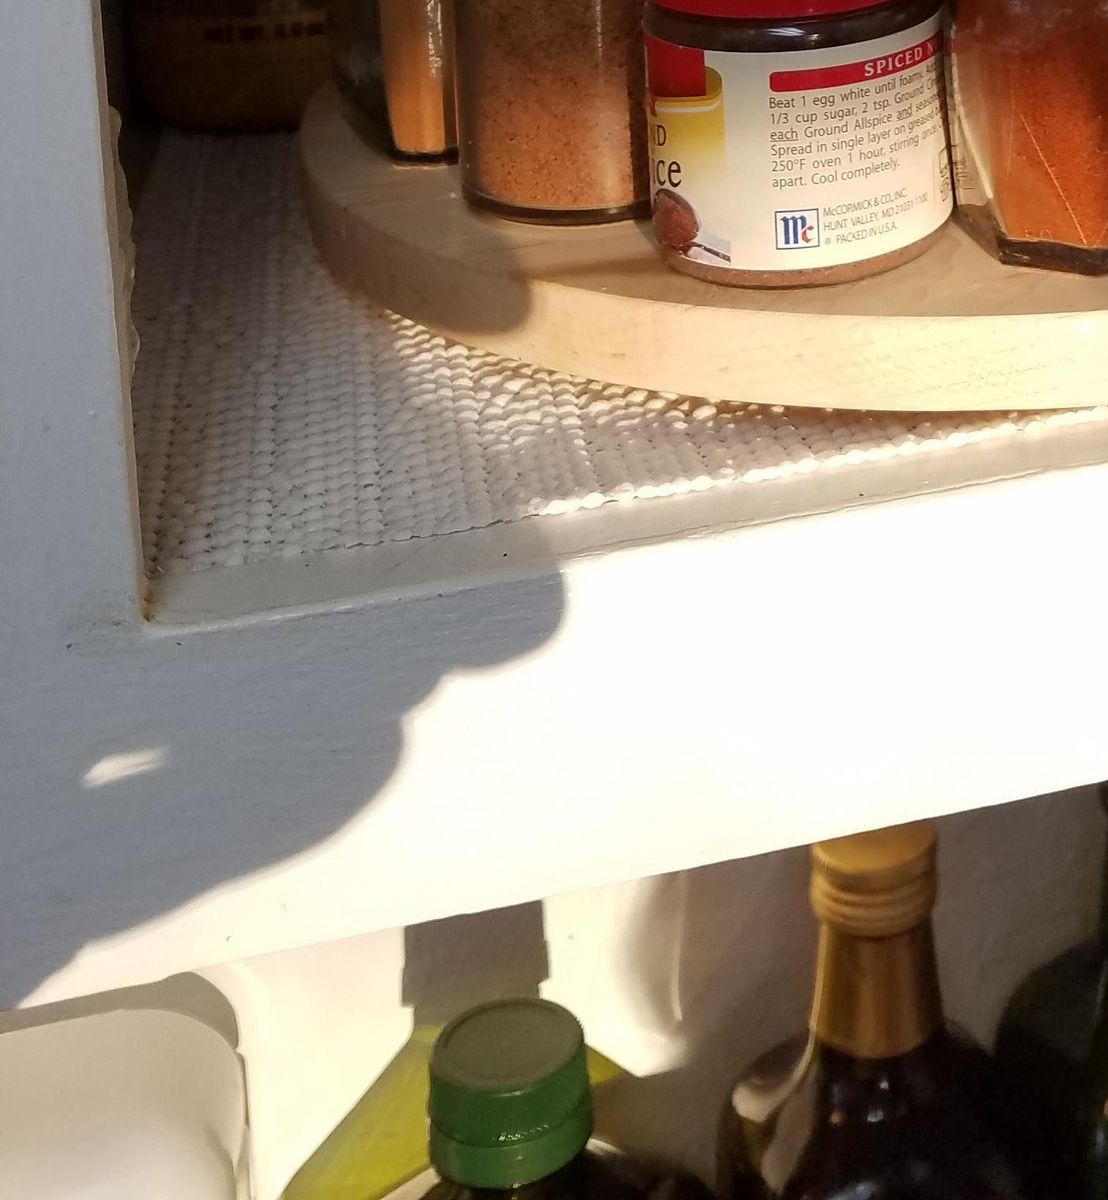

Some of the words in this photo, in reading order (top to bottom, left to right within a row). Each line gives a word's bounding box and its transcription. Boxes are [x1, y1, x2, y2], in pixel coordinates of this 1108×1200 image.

[864, 47, 923, 76] SPICED
[769, 97, 796, 109] Beat
[802, 96, 806, 107] 1
[813, 94, 836, 108] egg
[840, 87, 871, 102] white
[875, 80, 897, 94] until
[770, 113, 789, 125] 1/3
[795, 113, 818, 126] cup
[824, 106, 857, 122] sugar,
[862, 102, 868, 114] 2
[873, 99, 891, 111] tsp.
[894, 81, 924, 104] Ground
[770, 127, 799, 141] each
[804, 123, 848, 138] Ground
[854, 111, 892, 130] Allspice
[896, 104, 912, 121] and
[771, 141, 812, 158] Spread
[817, 141, 828, 152] in
[831, 135, 863, 152] single
[868, 128, 891, 146] layer
[894, 123, 905, 136] on
[812, 157, 841, 169] oven
[848, 152, 853, 163] 1
[859, 147, 886, 161] hour,
[772, 176, 807, 190] apart.
[811, 170, 838, 185] Cool
[841, 156, 900, 181] completely.
[823, 219, 848, 231] HUNT
[836, 228, 868, 244] PACKED
